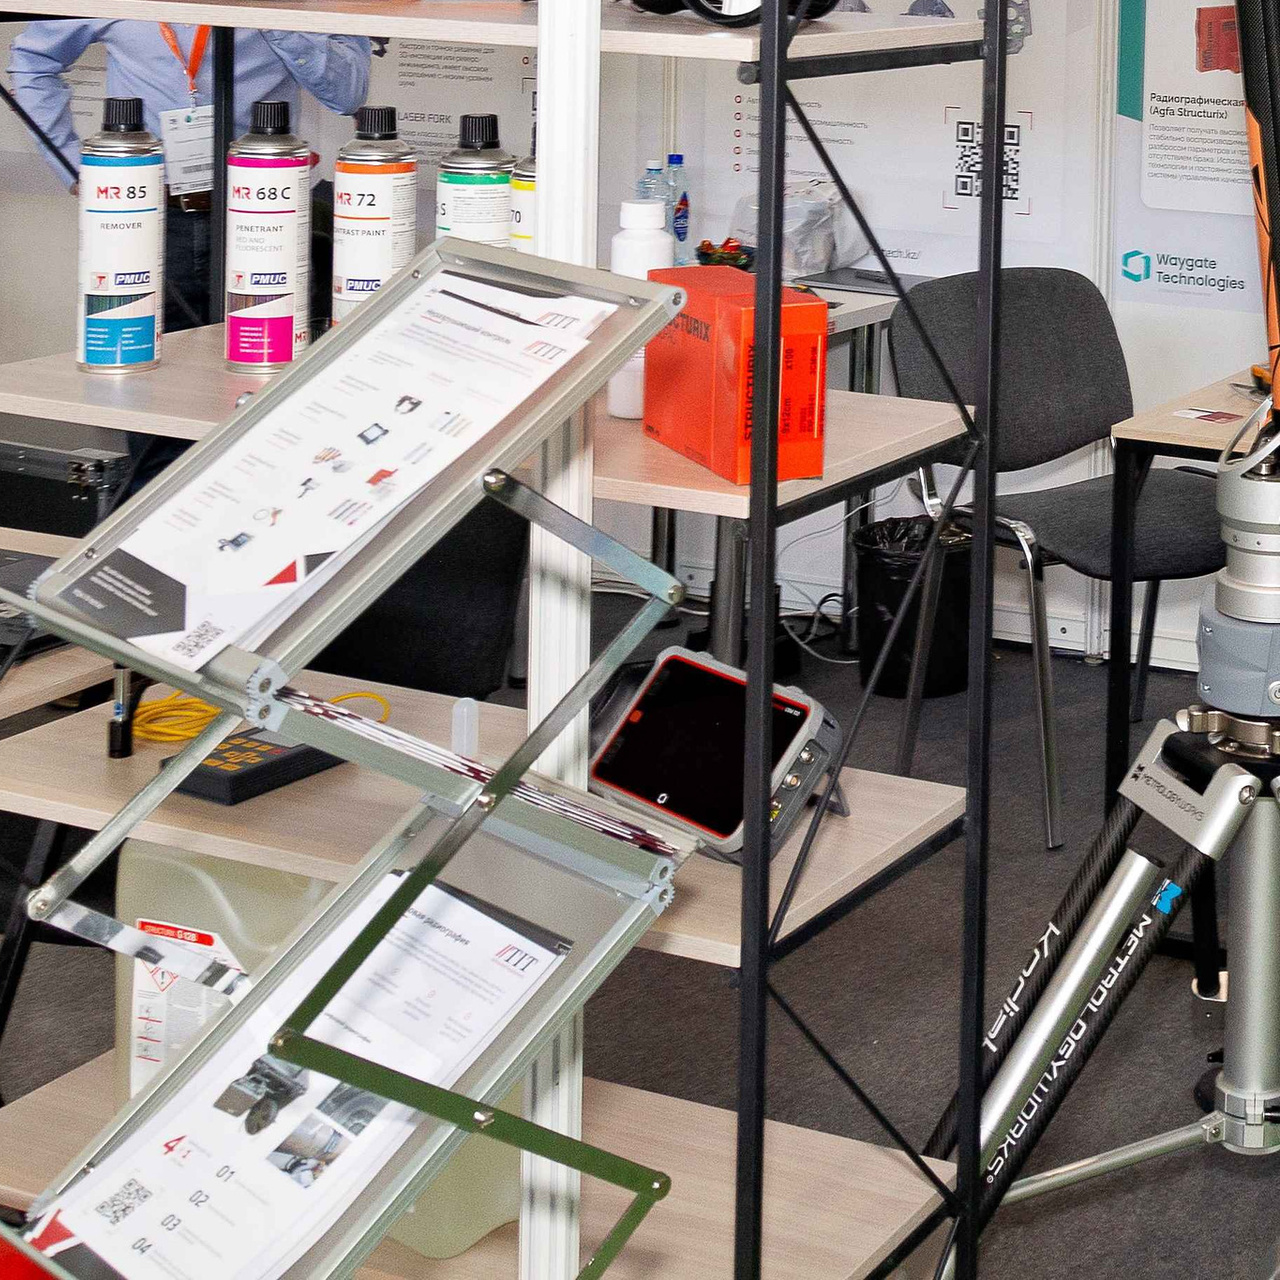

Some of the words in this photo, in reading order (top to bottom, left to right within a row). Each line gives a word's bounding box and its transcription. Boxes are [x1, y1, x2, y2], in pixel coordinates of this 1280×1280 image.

[1150, 93, 1246, 108] Радиографическая
[398, 111, 426, 122] LASER
[428, 113, 452, 124] FORK
[1149, 106, 1176, 119] (Agfa
[1177, 107, 1229, 120] Structurix)
[96, 186, 121, 200] MR
[126, 185, 147, 199] 85
[231, 185, 251, 200] MR
[335, 191, 352, 206] MR
[356, 193, 377, 207] 72
[100, 221, 143, 231] REMOVER
[235, 224, 284, 233] PENETRANT
[361, 229, 387, 237] PAINT
[1156, 253, 1217, 272] Waygate
[115, 271, 150, 285] PMUC
[251, 272, 287, 285] PMUC
[347, 279, 381, 291] PMUC
[1156, 271, 1246, 292] Technologies
[215, 1164, 236, 1183] 01
[188, 1189, 210, 1208] 02
[160, 1213, 182, 1232] 03
[131, 1236, 153, 1255] 04
